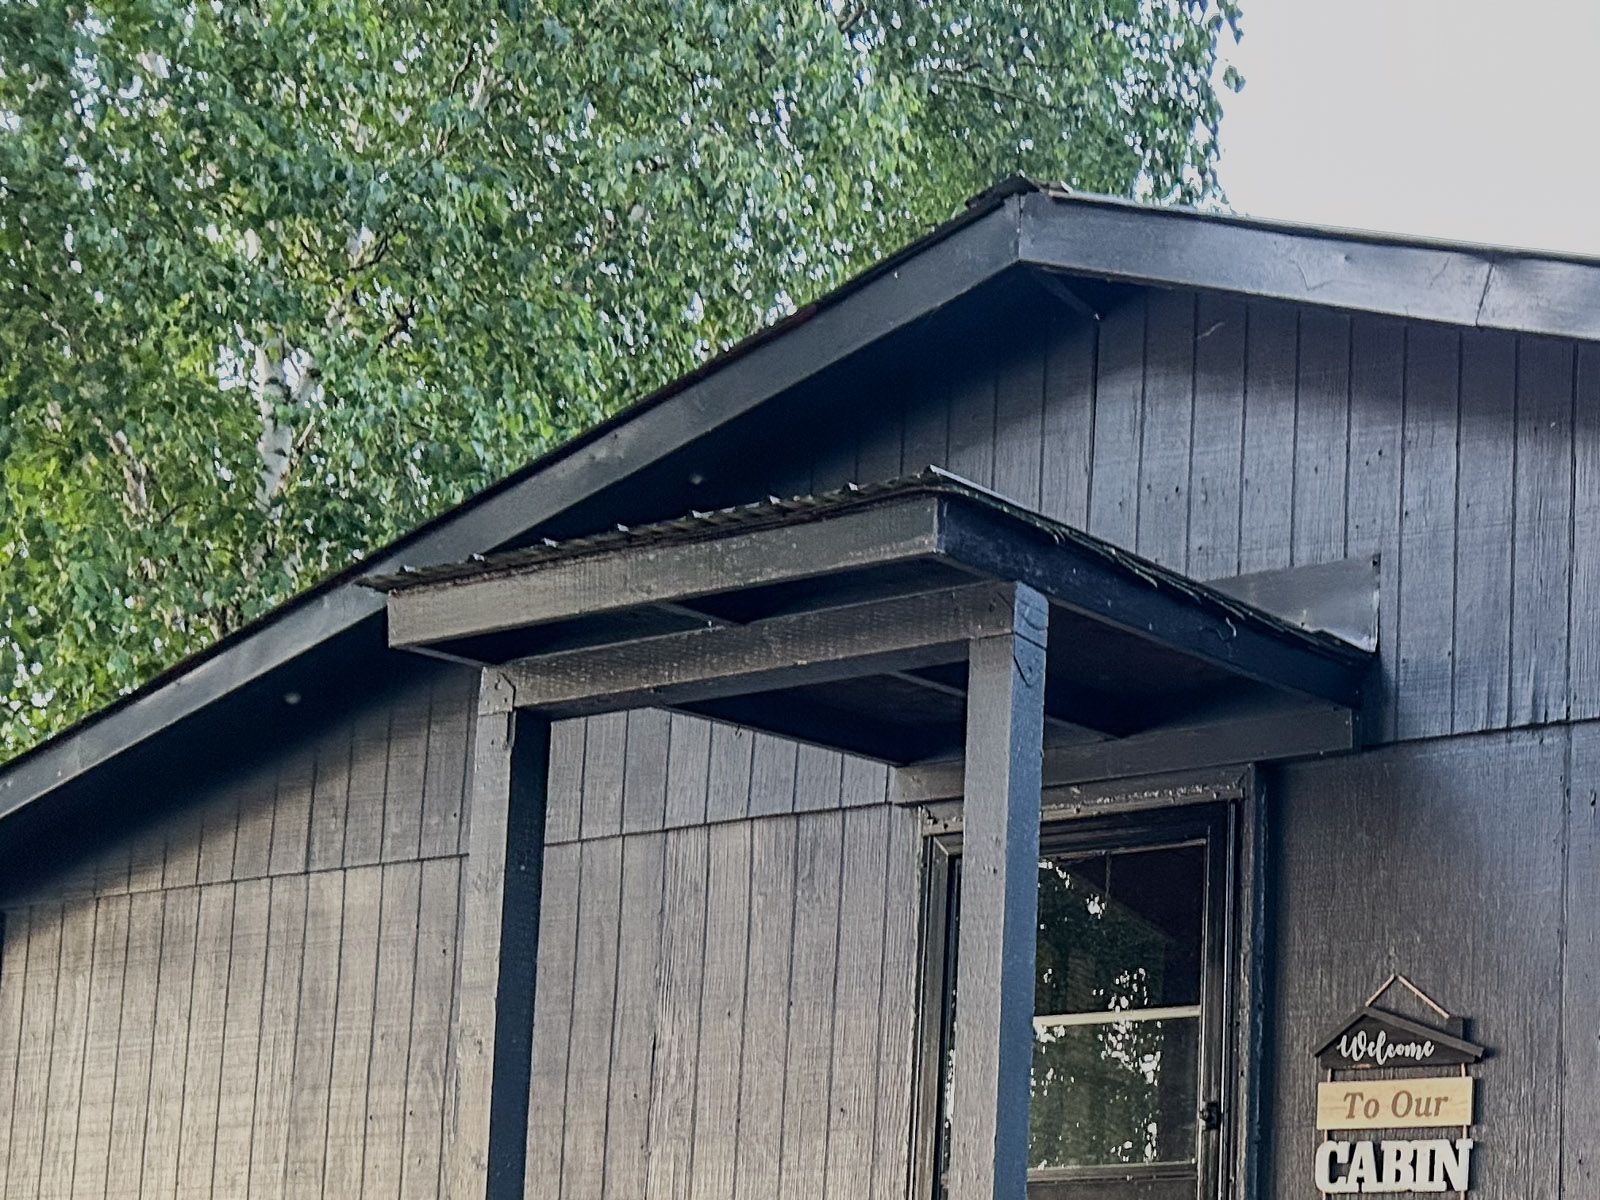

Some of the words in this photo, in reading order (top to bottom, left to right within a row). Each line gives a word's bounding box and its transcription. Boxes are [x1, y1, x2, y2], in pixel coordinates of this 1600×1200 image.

[1338, 1031, 1434, 1064] Welcome
[1344, 1092, 1379, 1119] To
[1391, 1090, 1448, 1118] Our
[1316, 1139, 1473, 1193] CABIN
